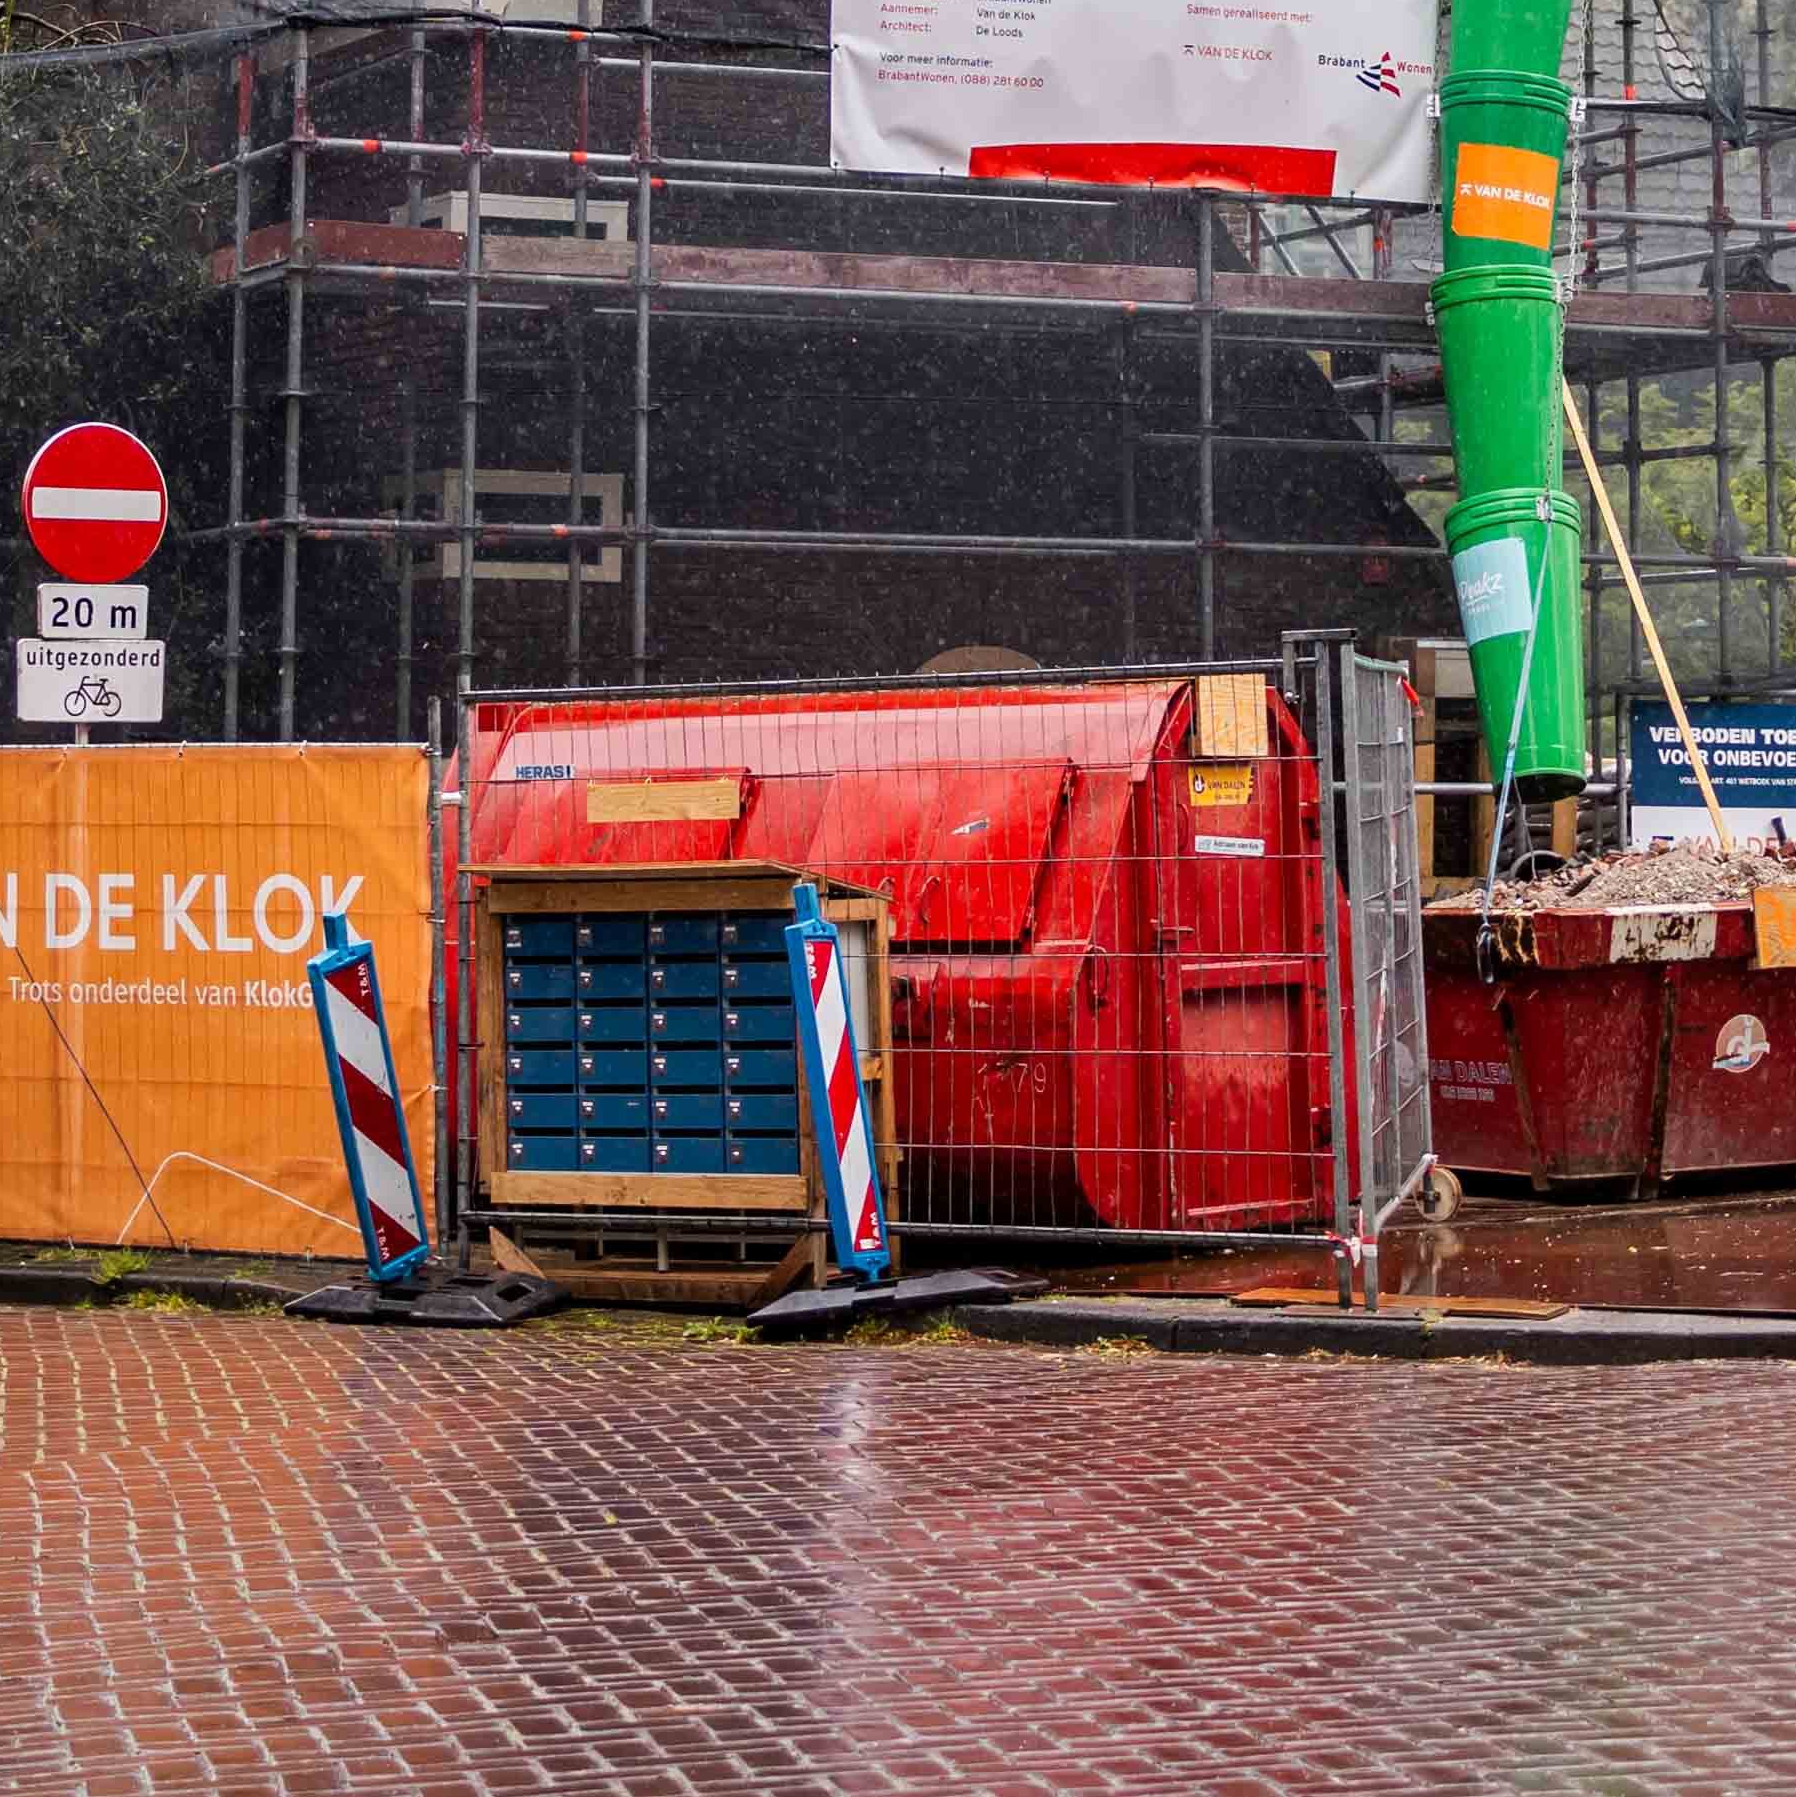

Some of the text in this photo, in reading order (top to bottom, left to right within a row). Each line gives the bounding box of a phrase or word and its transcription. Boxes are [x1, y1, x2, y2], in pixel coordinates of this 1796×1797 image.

[880, 3, 1036, 21] Aannemer: Van de Klok
[1186, 4, 1221, 17] Samen
[1223, 6, 1288, 21] gerealiseerd
[880, 20, 1023, 38] Architect: De Loods
[880, 51, 994, 68] Voor meer informatie:
[1197, 45, 1273, 61] VAN DE KLOK
[1318, 54, 1366, 69] Brabant
[1396, 61, 1433, 74] Wonen
[1474, 183, 1501, 198] VAN
[1504, 187, 1523, 201] DE
[52, 597, 137, 628] 20 m
[26, 647, 160, 670] uitgezonderd
[1658, 749, 1709, 766] VOOR
[44, 873, 136, 950] DE
[161, 873, 365, 954] KLOK
[8, 976, 315, 1009] Trots onderdeel van KlokG
